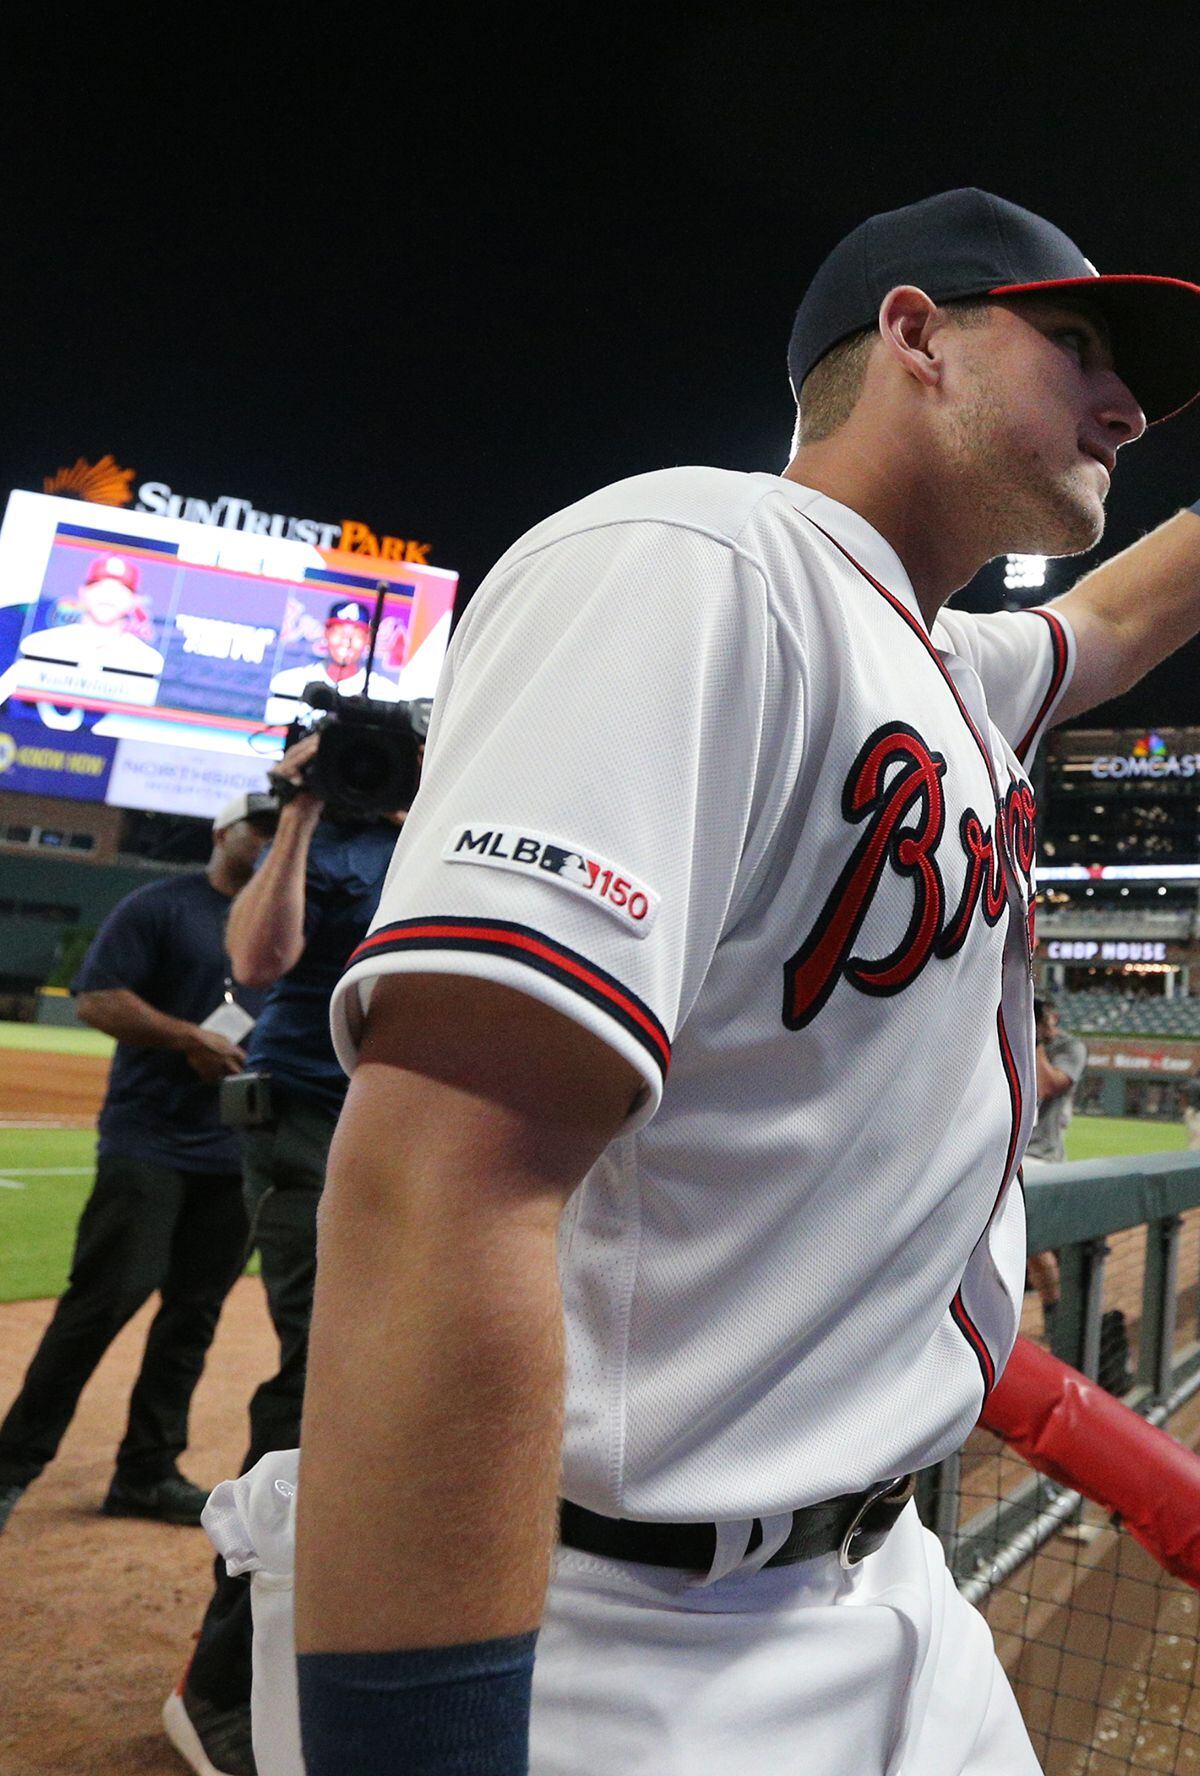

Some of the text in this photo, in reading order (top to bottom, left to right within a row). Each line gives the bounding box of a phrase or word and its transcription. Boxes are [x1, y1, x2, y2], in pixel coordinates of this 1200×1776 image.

[454, 829, 649, 920] MLB 150
[1047, 941, 1167, 961] CHOP HOUSE
